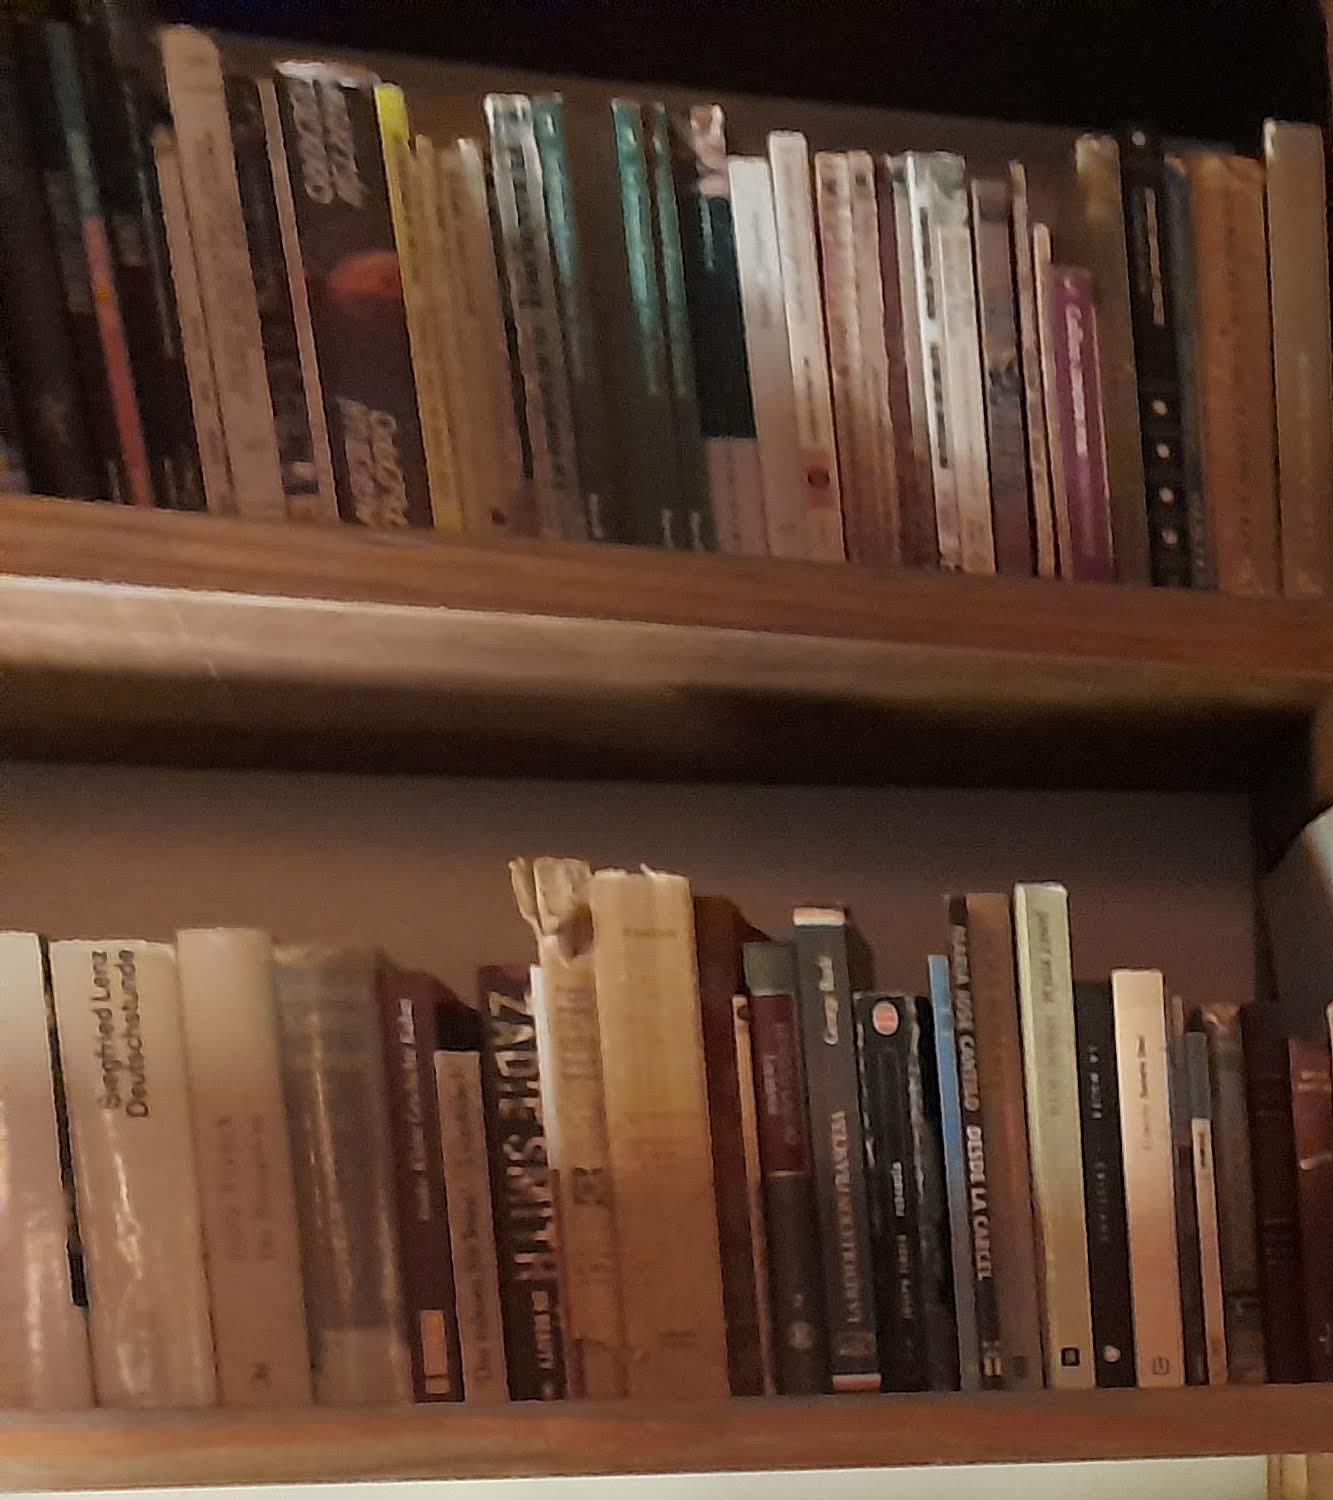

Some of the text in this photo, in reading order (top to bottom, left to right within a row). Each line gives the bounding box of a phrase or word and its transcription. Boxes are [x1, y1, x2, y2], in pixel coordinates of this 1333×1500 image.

[86, 950, 126, 1110] Siegfried Lenz
[110, 949, 149, 1119] Deutschstunde
[487, 987, 544, 1122] ZADIE
[501, 1130, 558, 1281] SMITH
[964, 1125, 985, 1183] DESDE
[969, 1186, 988, 1211] LA
